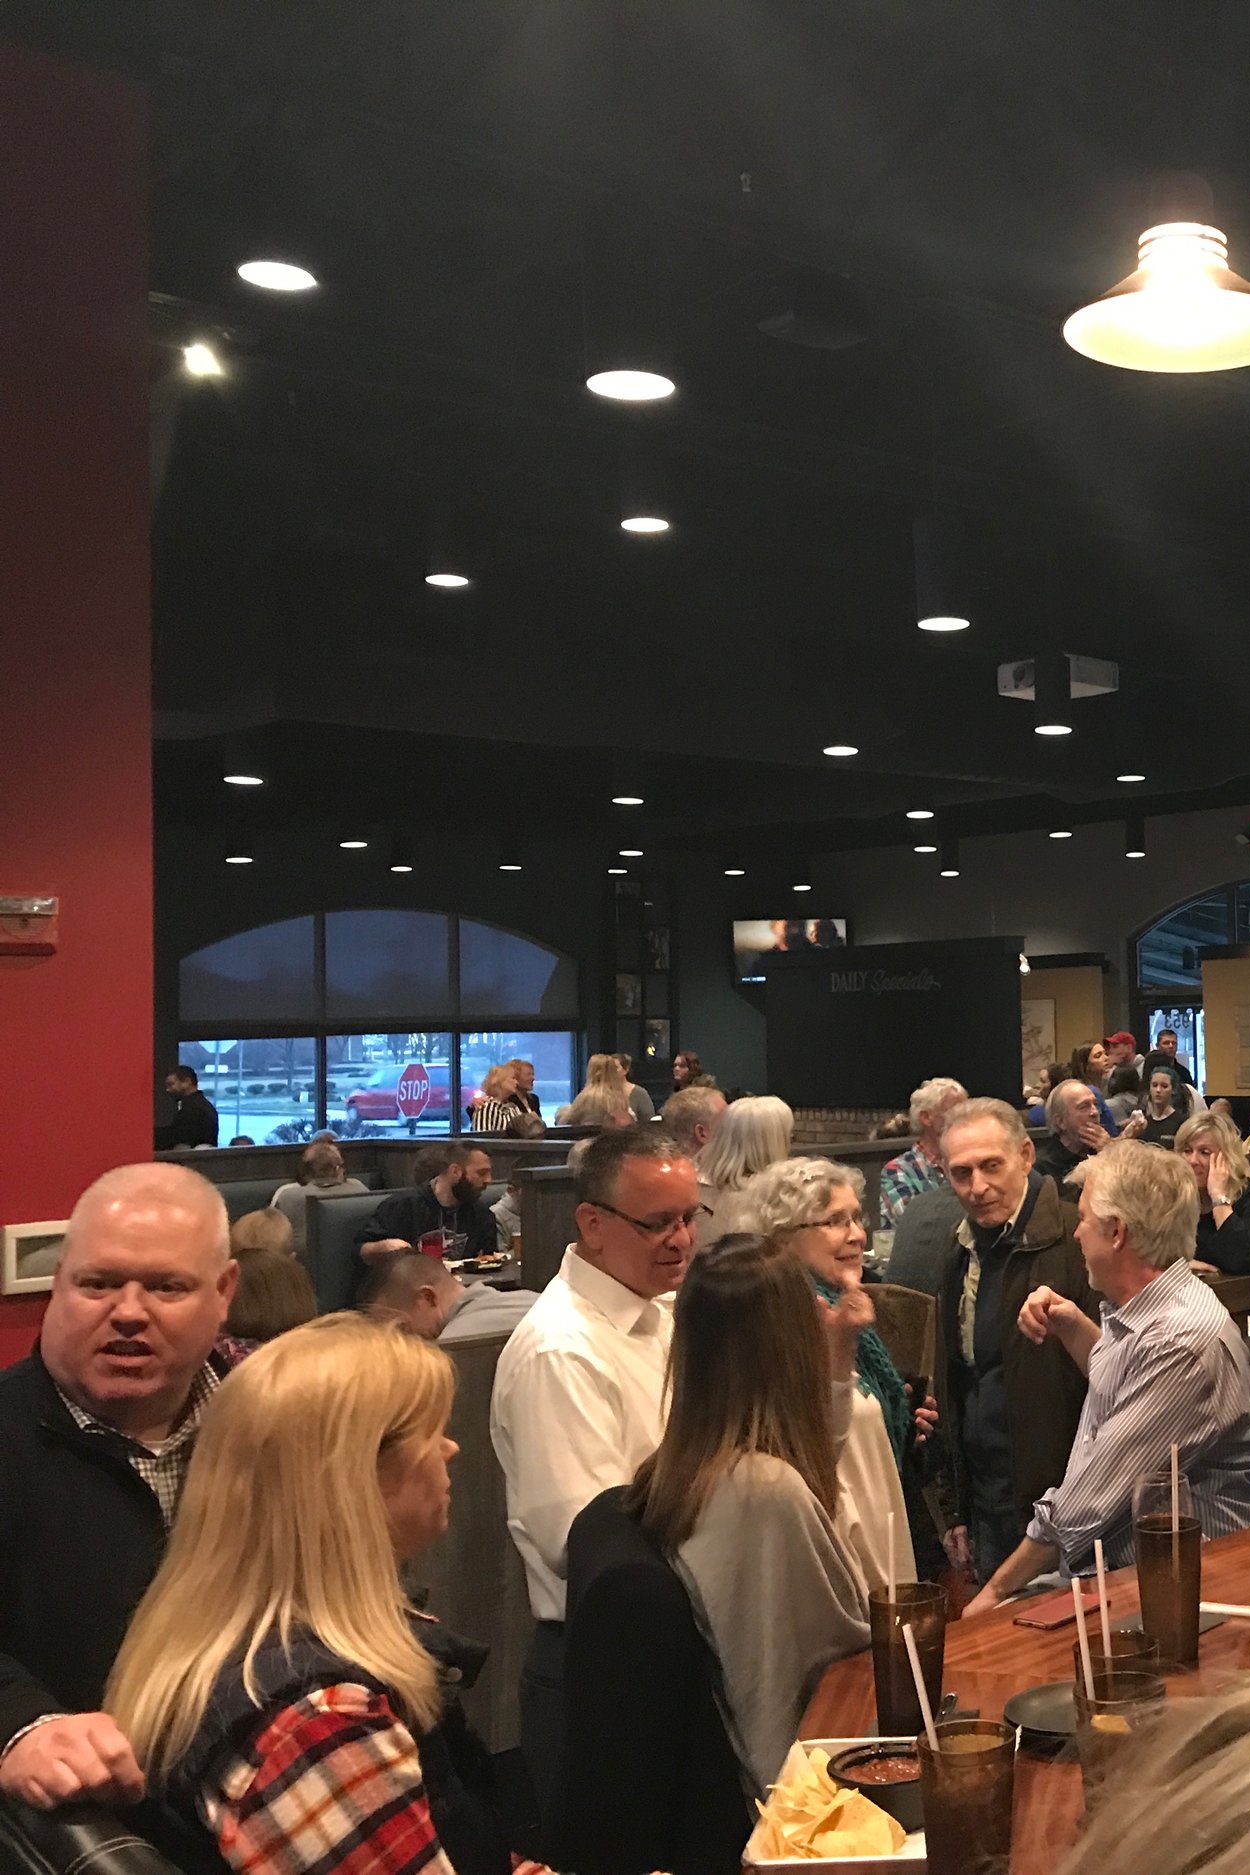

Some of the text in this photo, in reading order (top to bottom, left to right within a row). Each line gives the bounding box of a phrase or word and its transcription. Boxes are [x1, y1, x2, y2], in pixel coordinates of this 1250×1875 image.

[830, 968, 941, 995] DAILY Specials
[399, 1079, 429, 1102] STOP
